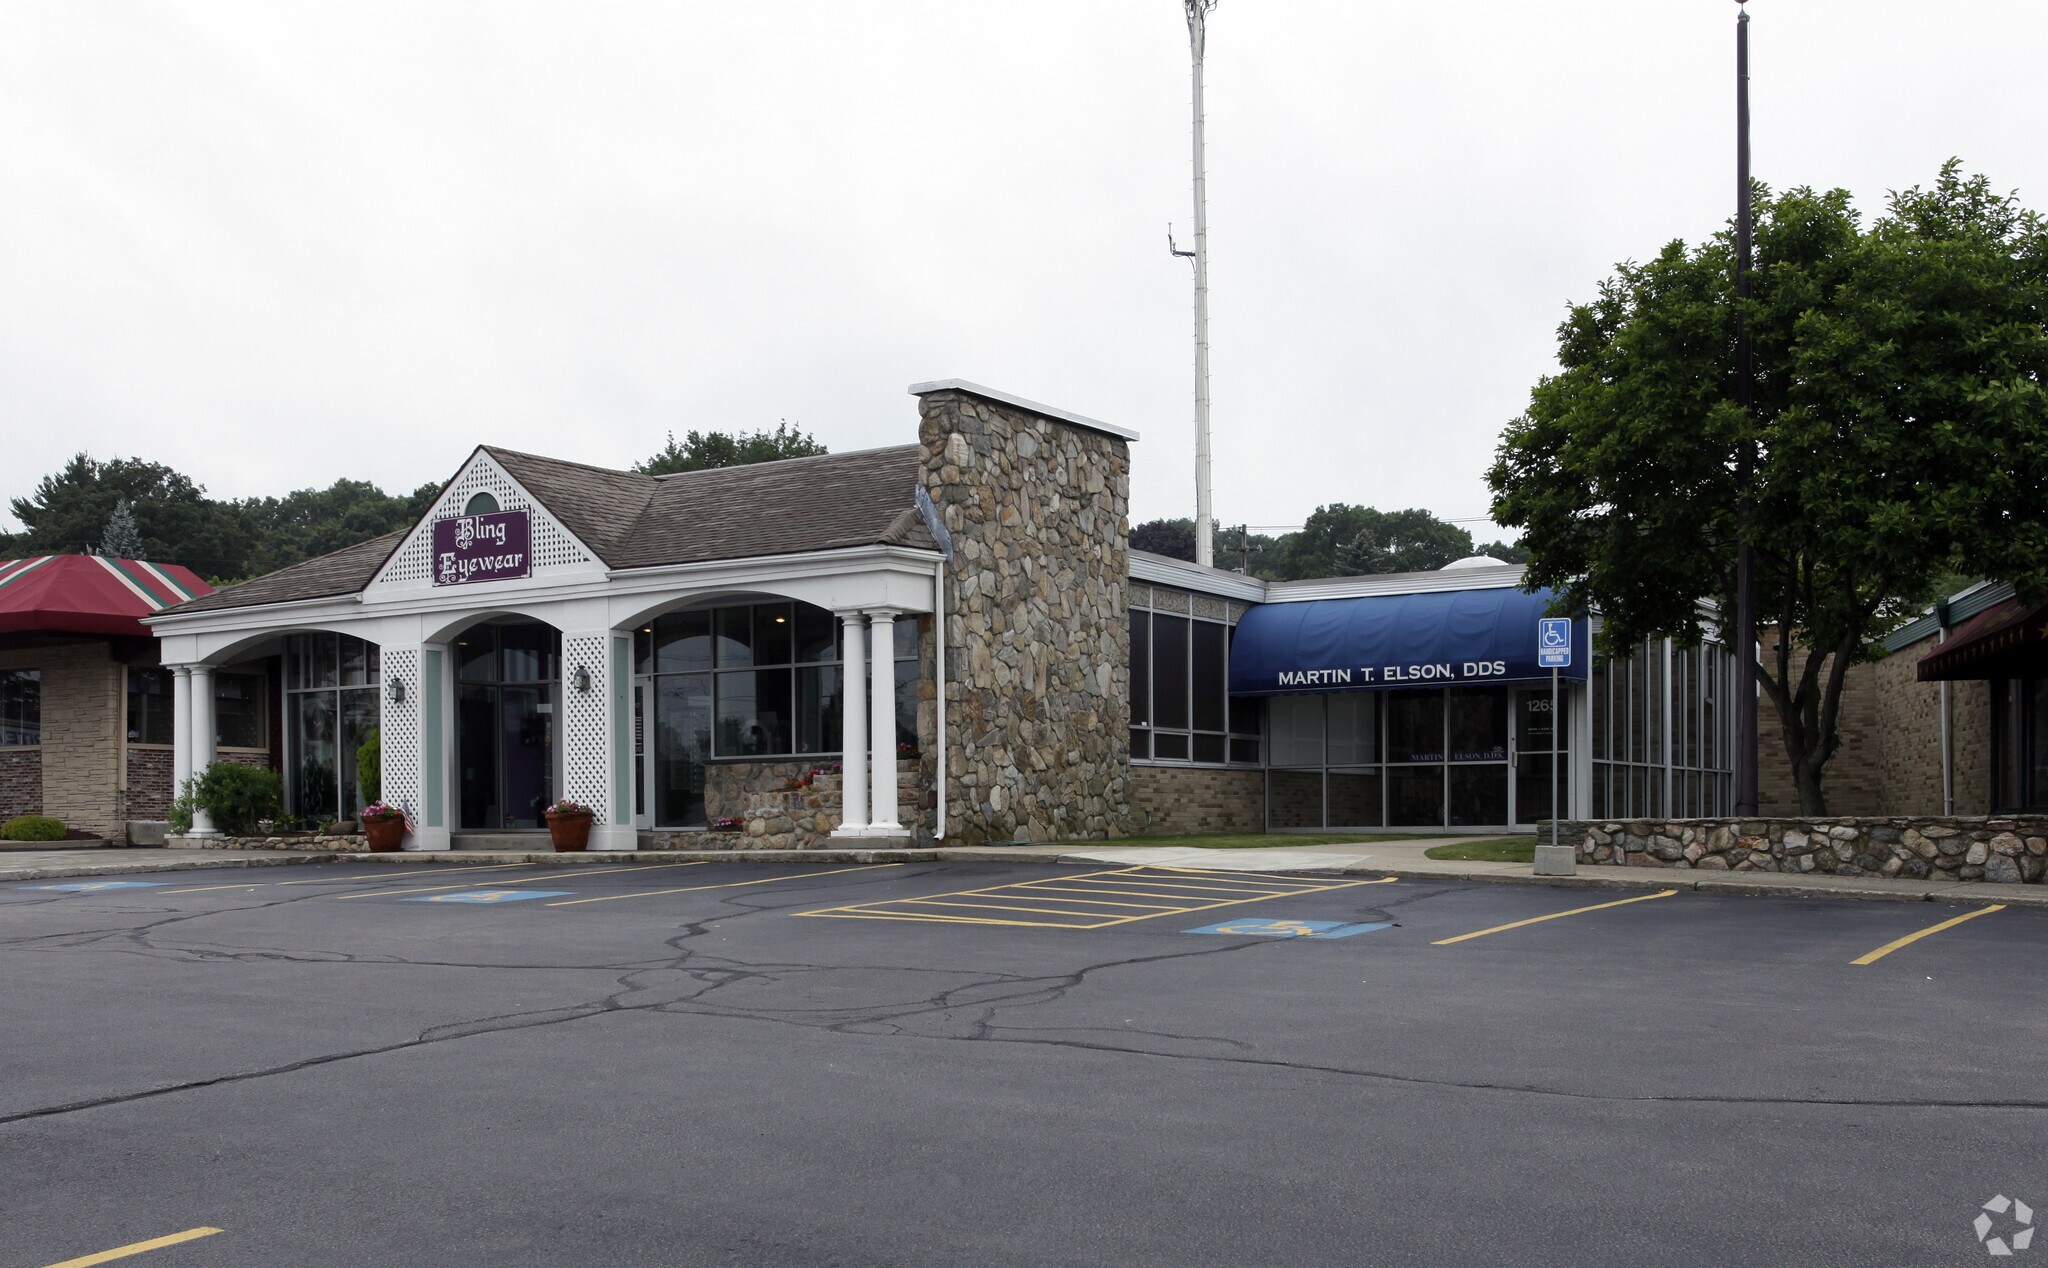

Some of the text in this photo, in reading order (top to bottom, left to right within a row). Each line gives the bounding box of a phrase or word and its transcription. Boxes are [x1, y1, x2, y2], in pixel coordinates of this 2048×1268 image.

[455, 516, 506, 549] Bling
[439, 552, 523, 583] Eyewear
[1540, 647, 1569, 655] HANDICAPPED
[1278, 661, 1506, 686] MARTIN T. ELSON, DDS
[1411, 753, 1443, 761] MARTIN
